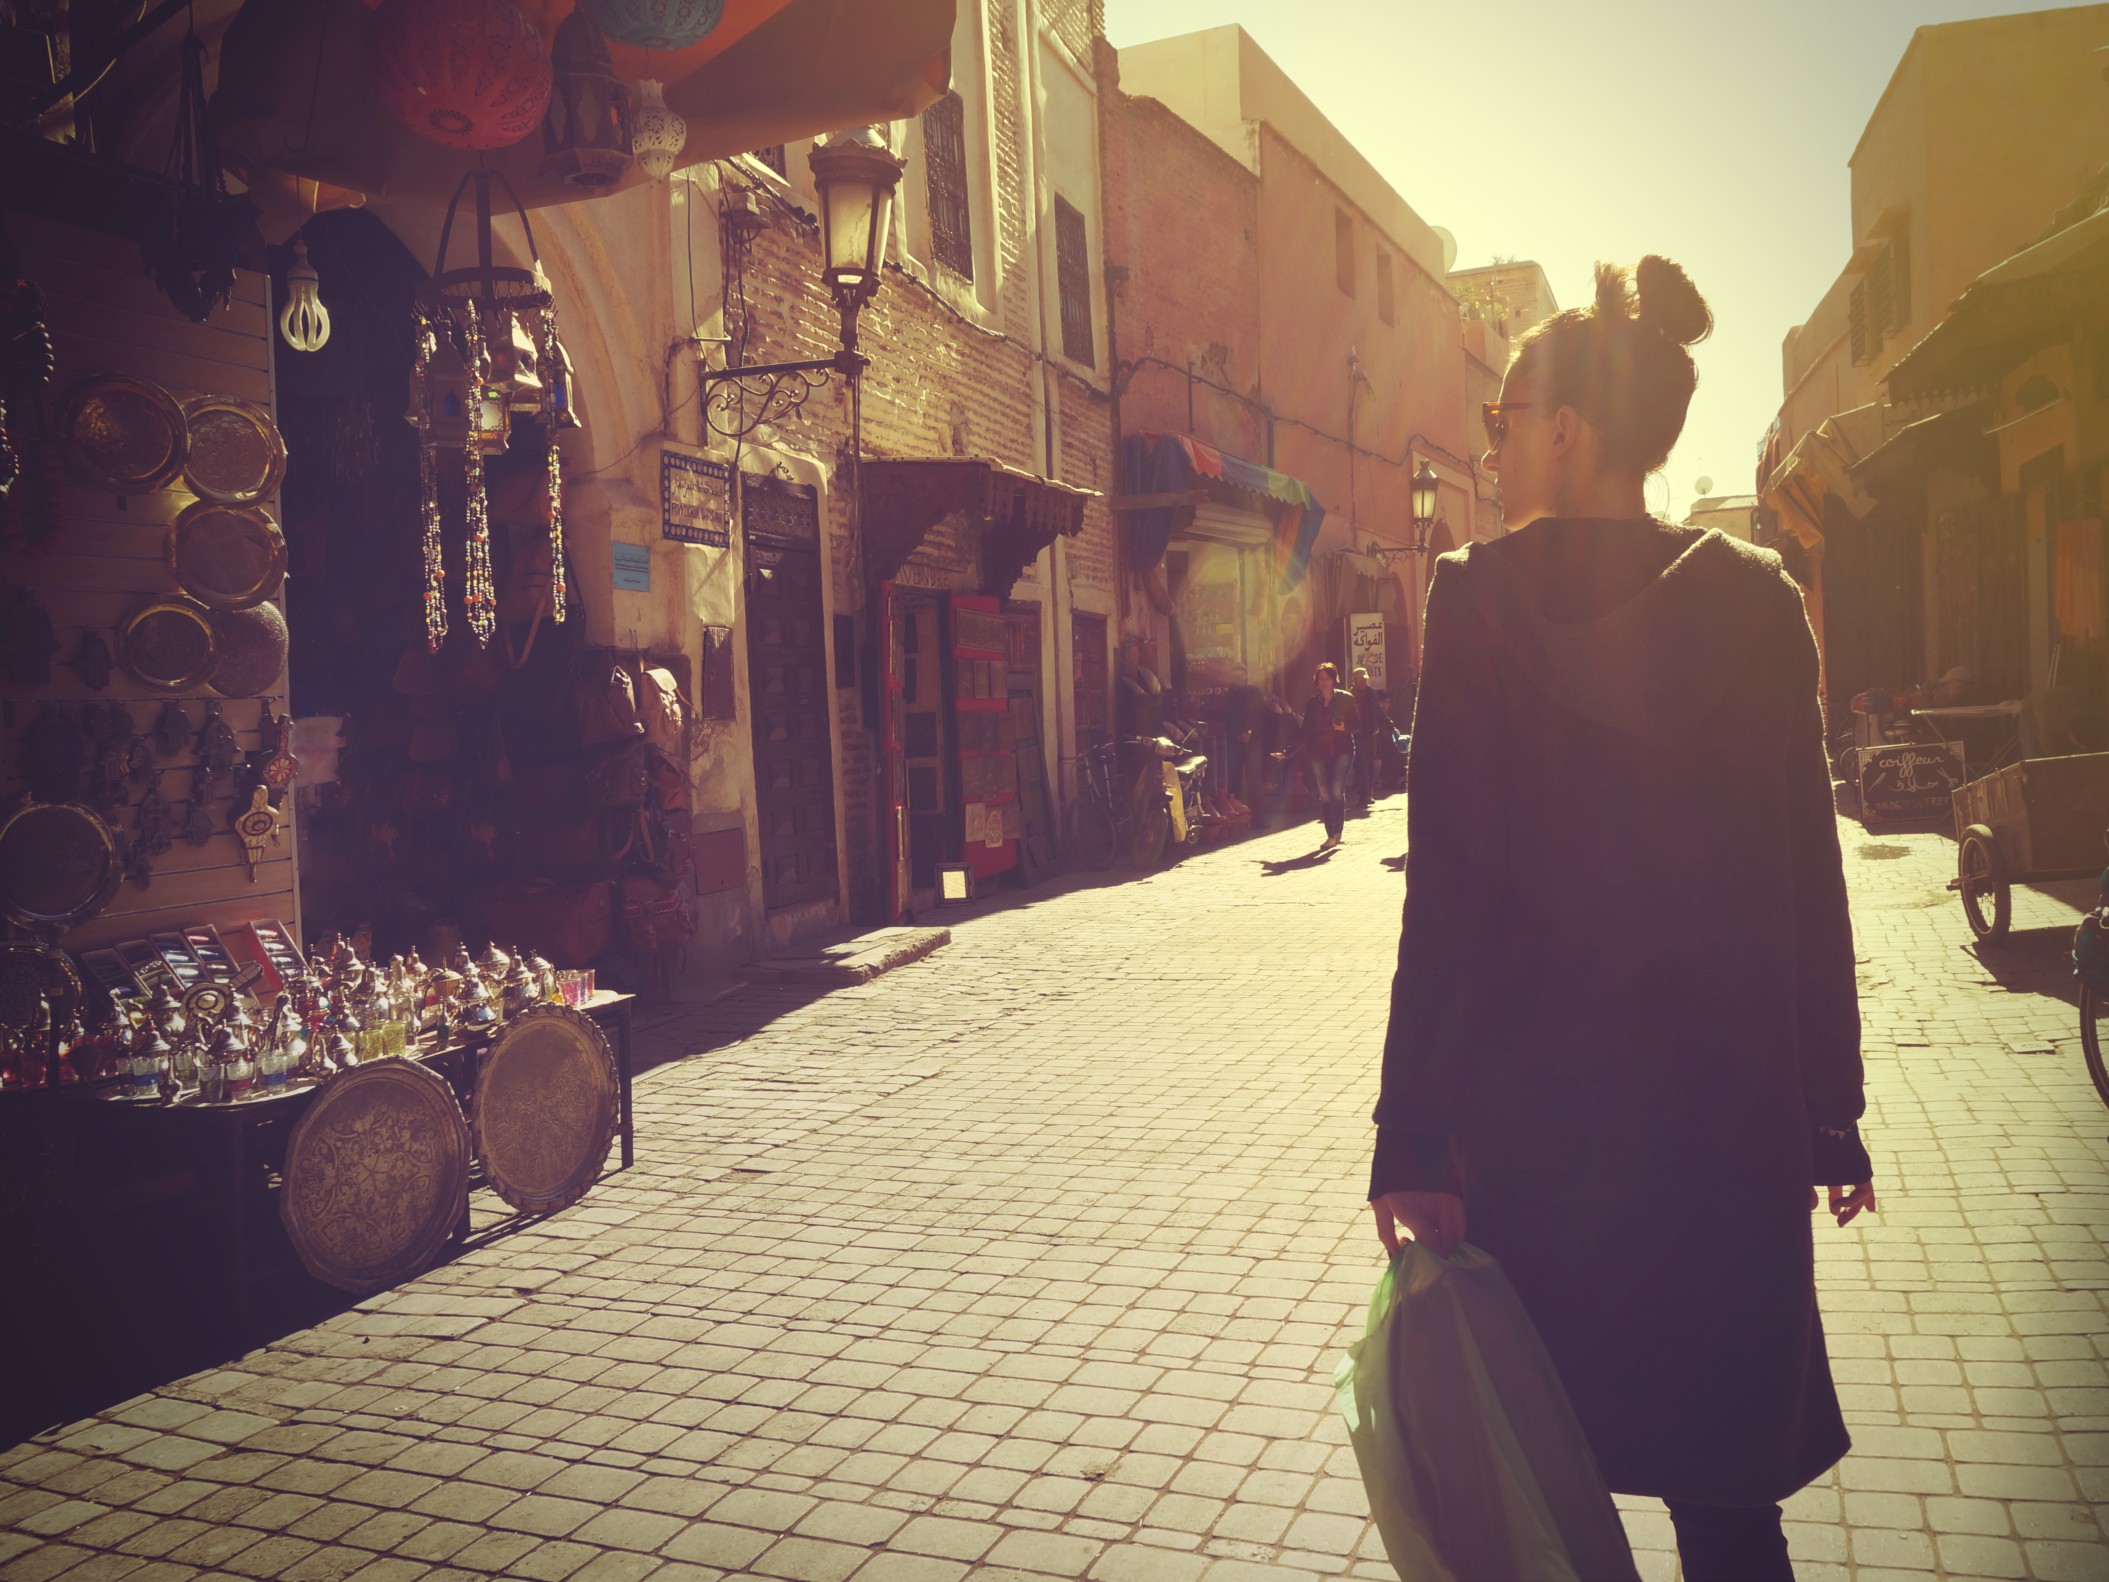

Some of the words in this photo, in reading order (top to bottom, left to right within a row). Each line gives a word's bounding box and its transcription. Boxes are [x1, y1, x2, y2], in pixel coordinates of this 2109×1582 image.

[1353, 622, 1383, 636] عصير
[1879, 752, 1944, 778] coiffeur
[1888, 775, 1939, 792] حلاق
